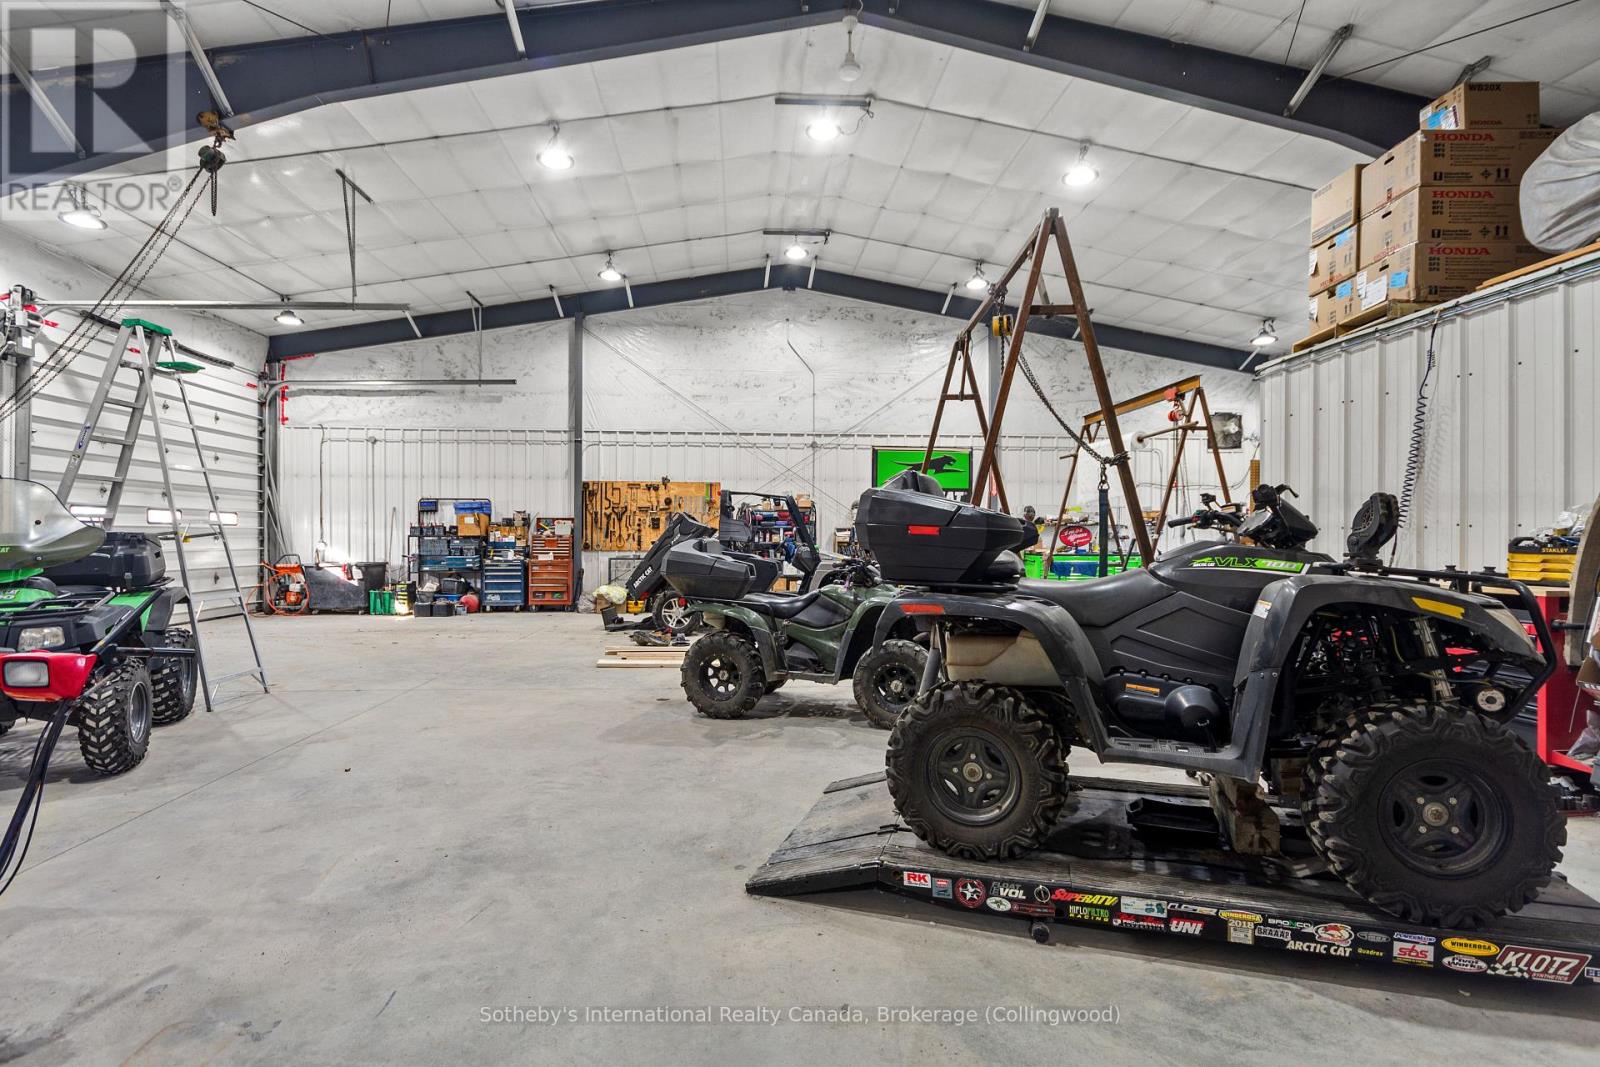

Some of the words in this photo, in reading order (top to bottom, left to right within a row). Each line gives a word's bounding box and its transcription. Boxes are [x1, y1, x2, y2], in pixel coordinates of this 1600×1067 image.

[1433, 133, 1494, 141] HONDA
[1432, 190, 1494, 199] HONDA
[1428, 247, 1490, 256] HONDA
[633, 573, 647, 588] ARCTIC
[644, 566, 652, 576] CAT
[906, 872, 928, 883] RK
[989, 881, 1022, 891] FLOAT
[1069, 913, 1109, 922] RACING
[1169, 920, 1203, 935] UNI
[1228, 919, 1255, 929] 2018
[1268, 918, 1311, 929] BRONCO
[1257, 927, 1291, 940] BRAAAP
[1286, 940, 1328, 954] ARCTIC
[1329, 945, 1352, 957] CAT
[1397, 944, 1429, 959] sbs
[1450, 941, 1492, 951] WINDEROSA
[1501, 951, 1580, 976] KLOTZ
